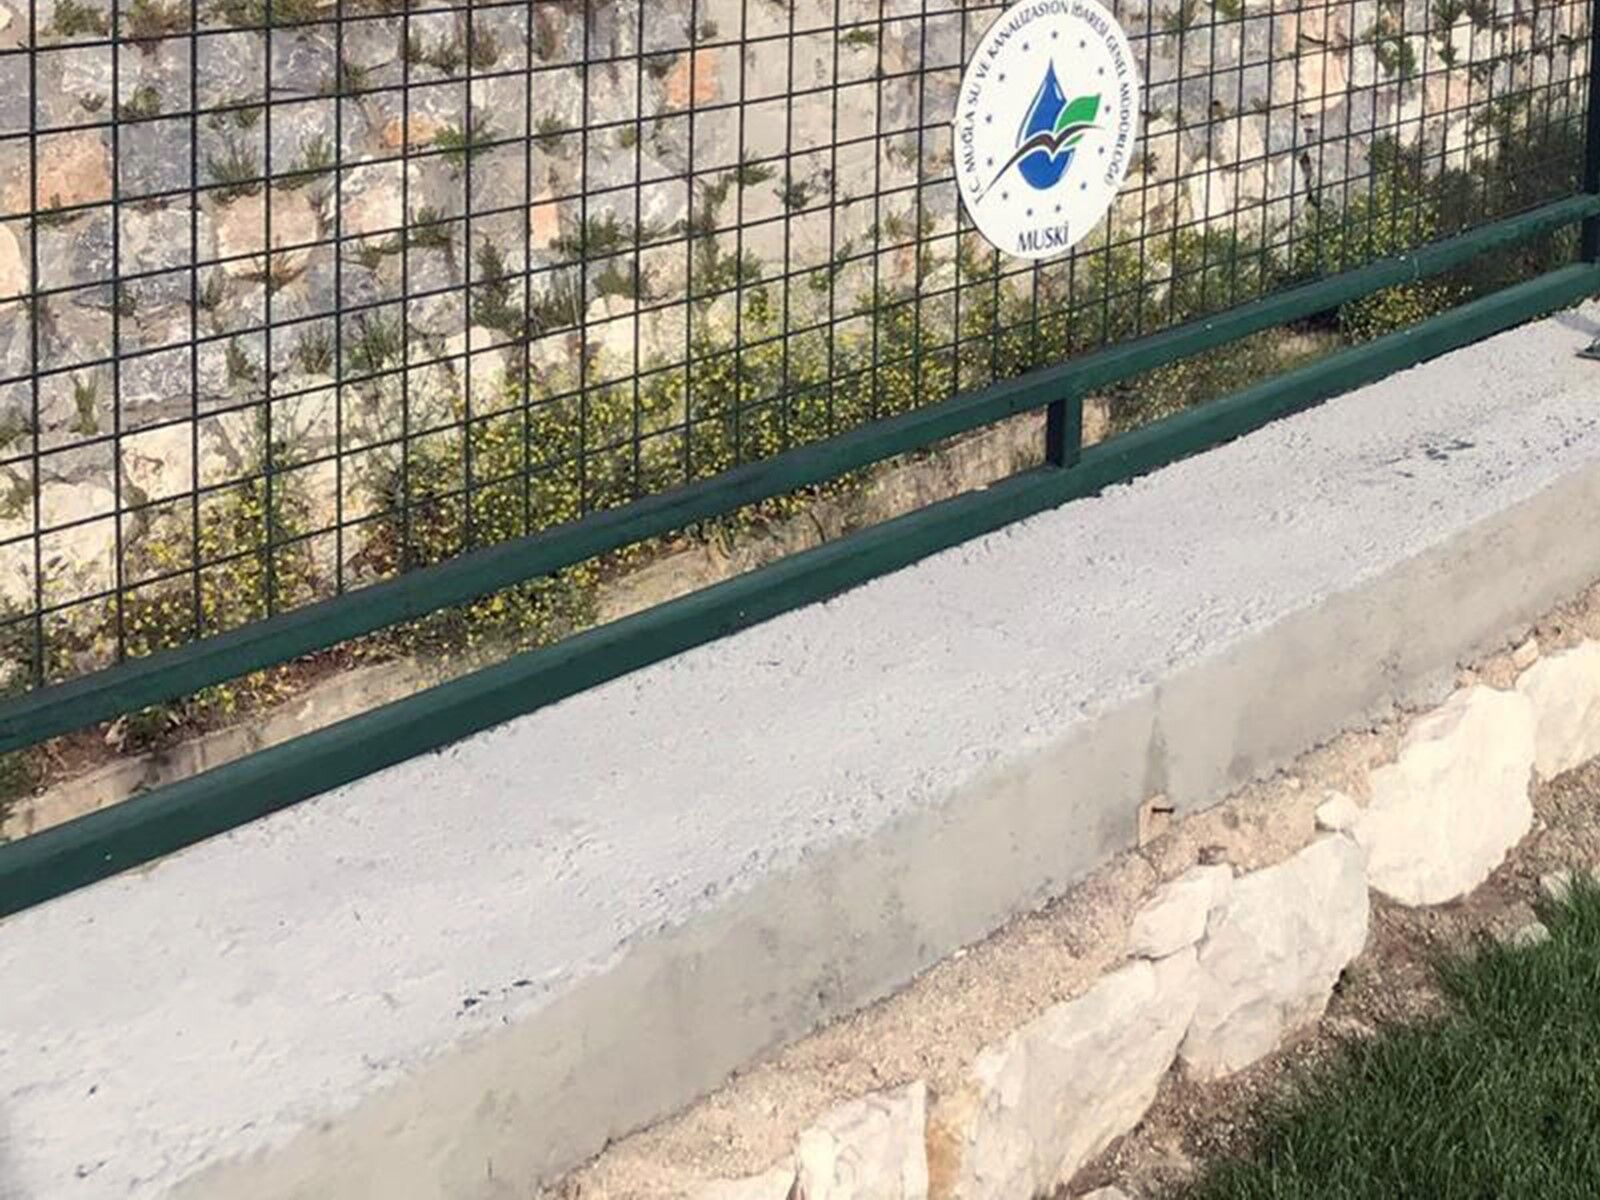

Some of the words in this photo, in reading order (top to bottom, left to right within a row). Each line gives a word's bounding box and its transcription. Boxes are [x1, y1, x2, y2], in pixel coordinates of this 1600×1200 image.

[975, 62, 991, 79] VE
[1105, 34, 1128, 78] GENEL
[967, 81, 982, 105] SU
[961, 110, 976, 173] MUĞLA
[1016, 220, 1069, 252] MUSKİ
